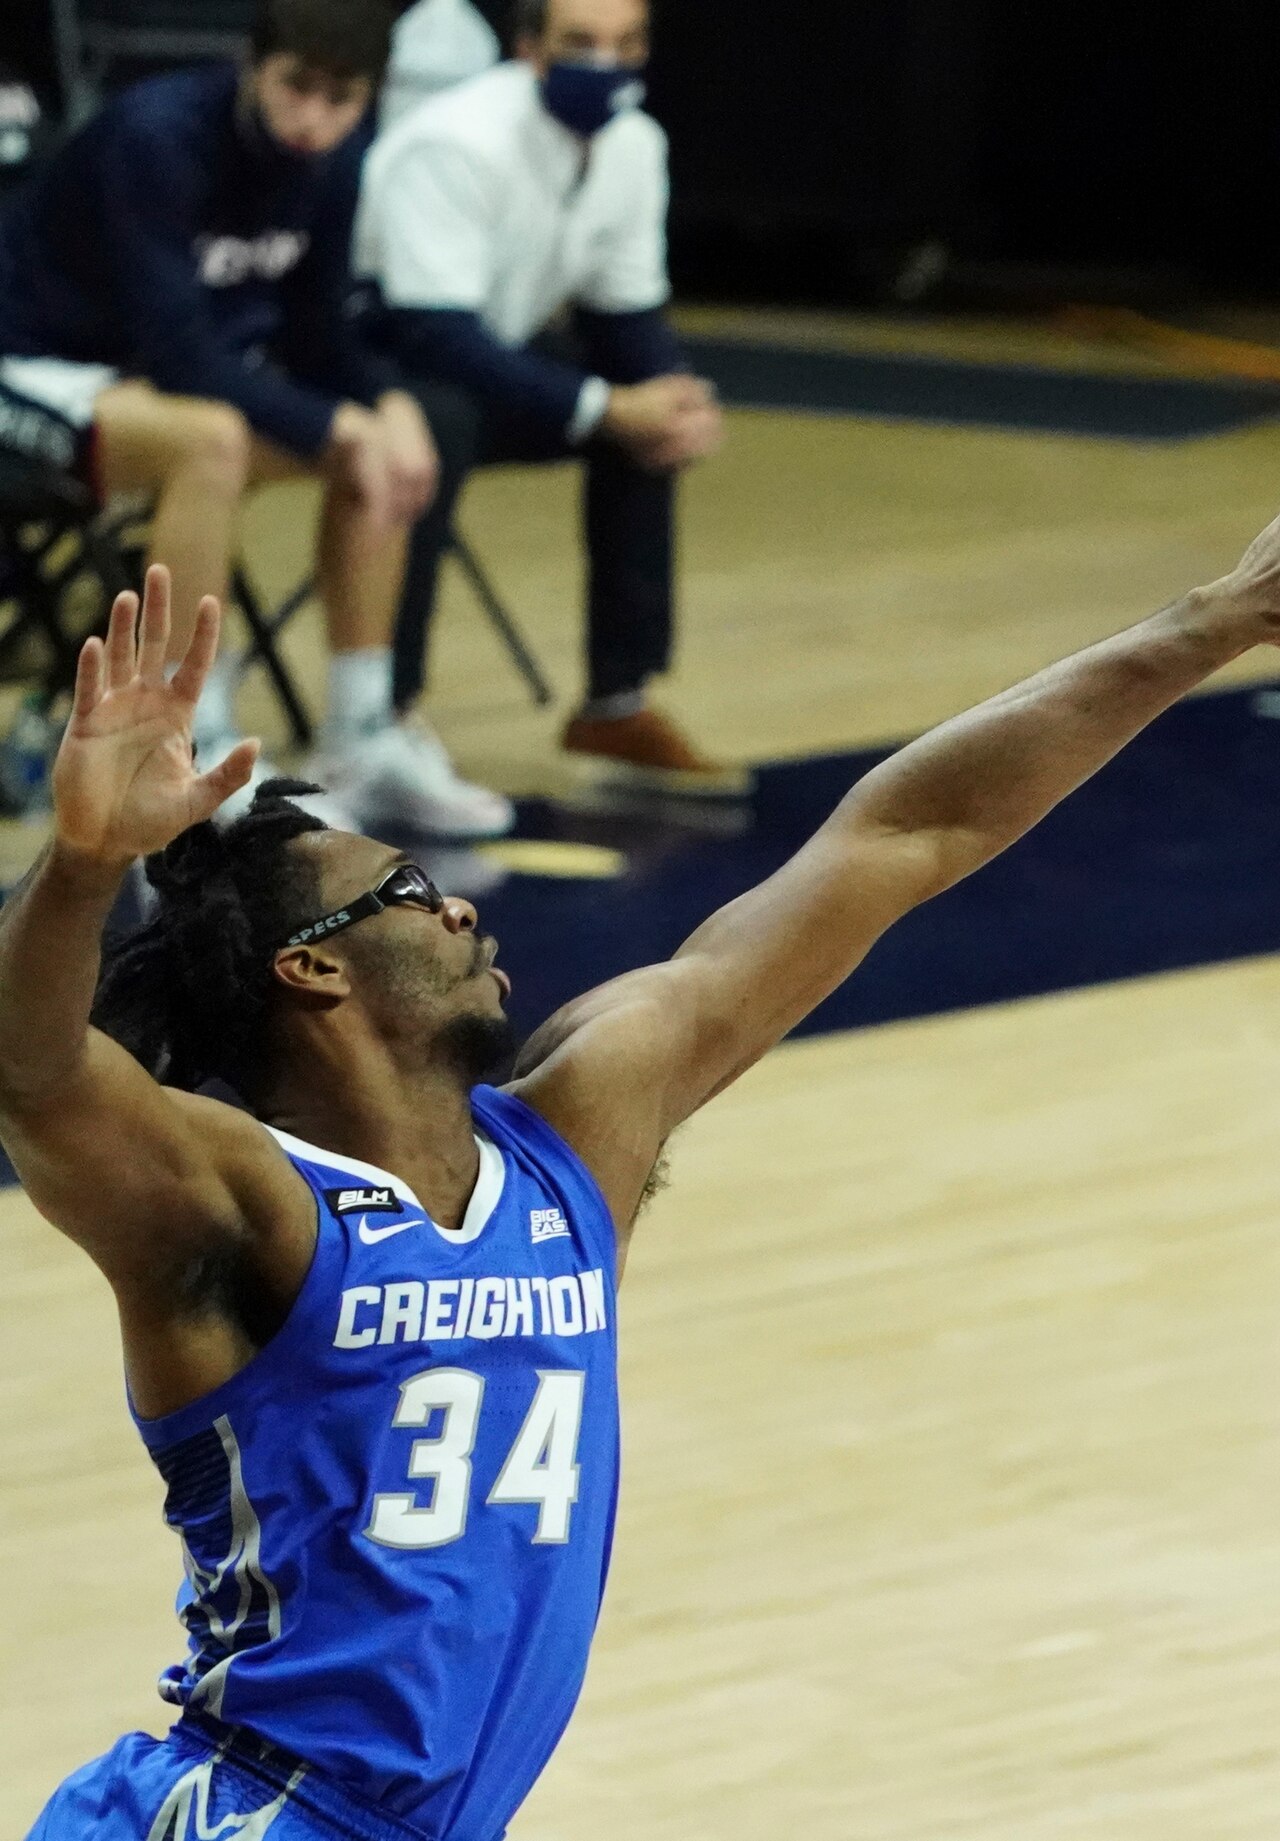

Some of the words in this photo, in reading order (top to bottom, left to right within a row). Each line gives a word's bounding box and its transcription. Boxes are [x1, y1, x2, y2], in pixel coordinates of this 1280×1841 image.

[288, 910, 351, 946] SPECS
[337, 1189, 389, 1204] BLM
[530, 1208, 560, 1223] BIG
[332, 1268, 607, 1350] CREIGHTON
[362, 1366, 587, 1550] 34
